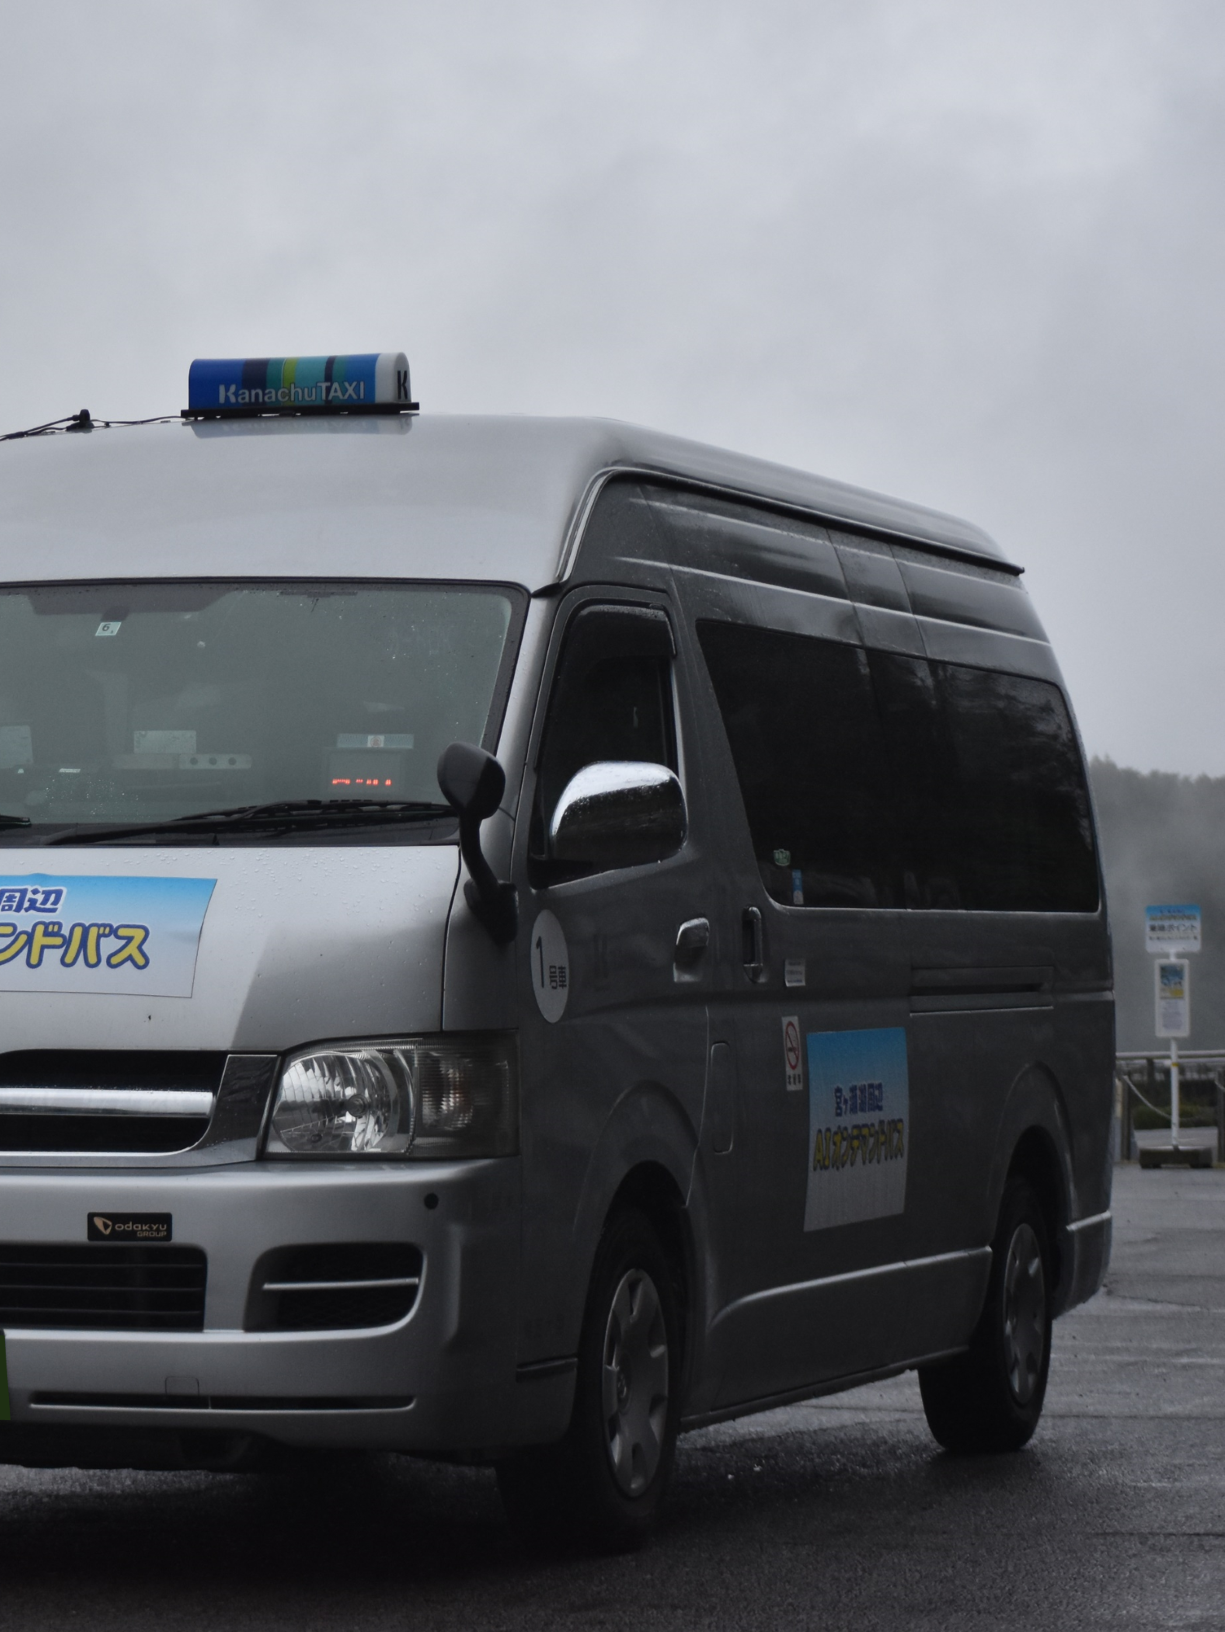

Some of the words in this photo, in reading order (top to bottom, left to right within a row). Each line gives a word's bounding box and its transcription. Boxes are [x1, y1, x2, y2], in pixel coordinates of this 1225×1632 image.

[397, 370, 409, 400] K
[1149, 924, 1197, 932] ポイント
[115, 1221, 167, 1231] odakyu
